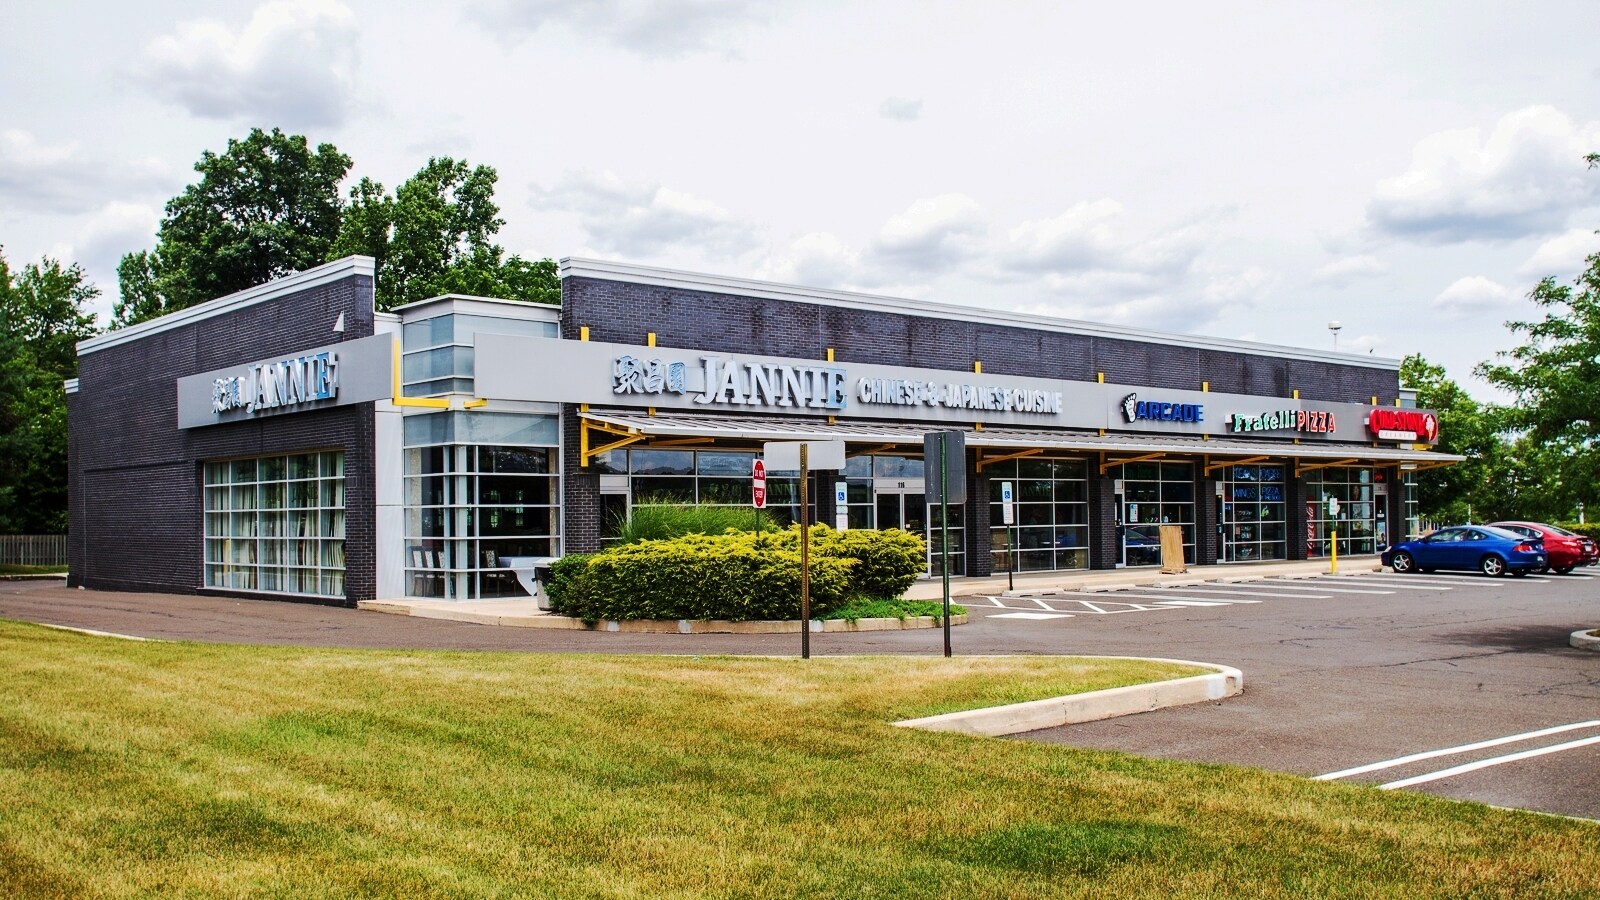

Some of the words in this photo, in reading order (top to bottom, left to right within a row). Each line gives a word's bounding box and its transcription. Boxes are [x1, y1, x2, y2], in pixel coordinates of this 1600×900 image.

[247, 352, 339, 414] JANNIE
[694, 355, 847, 409] JANNIE
[857, 376, 923, 405] CHINESE
[926, 381, 941, 407] &
[944, 383, 1013, 411] JAPANESE
[1012, 388, 1063, 414] CUISINE
[1136, 400, 1204, 422] ARCADE
[1232, 409, 1296, 432] Fratelli
[1296, 410, 1336, 433] PIZZA
[755, 490, 763, 498] ENTER
